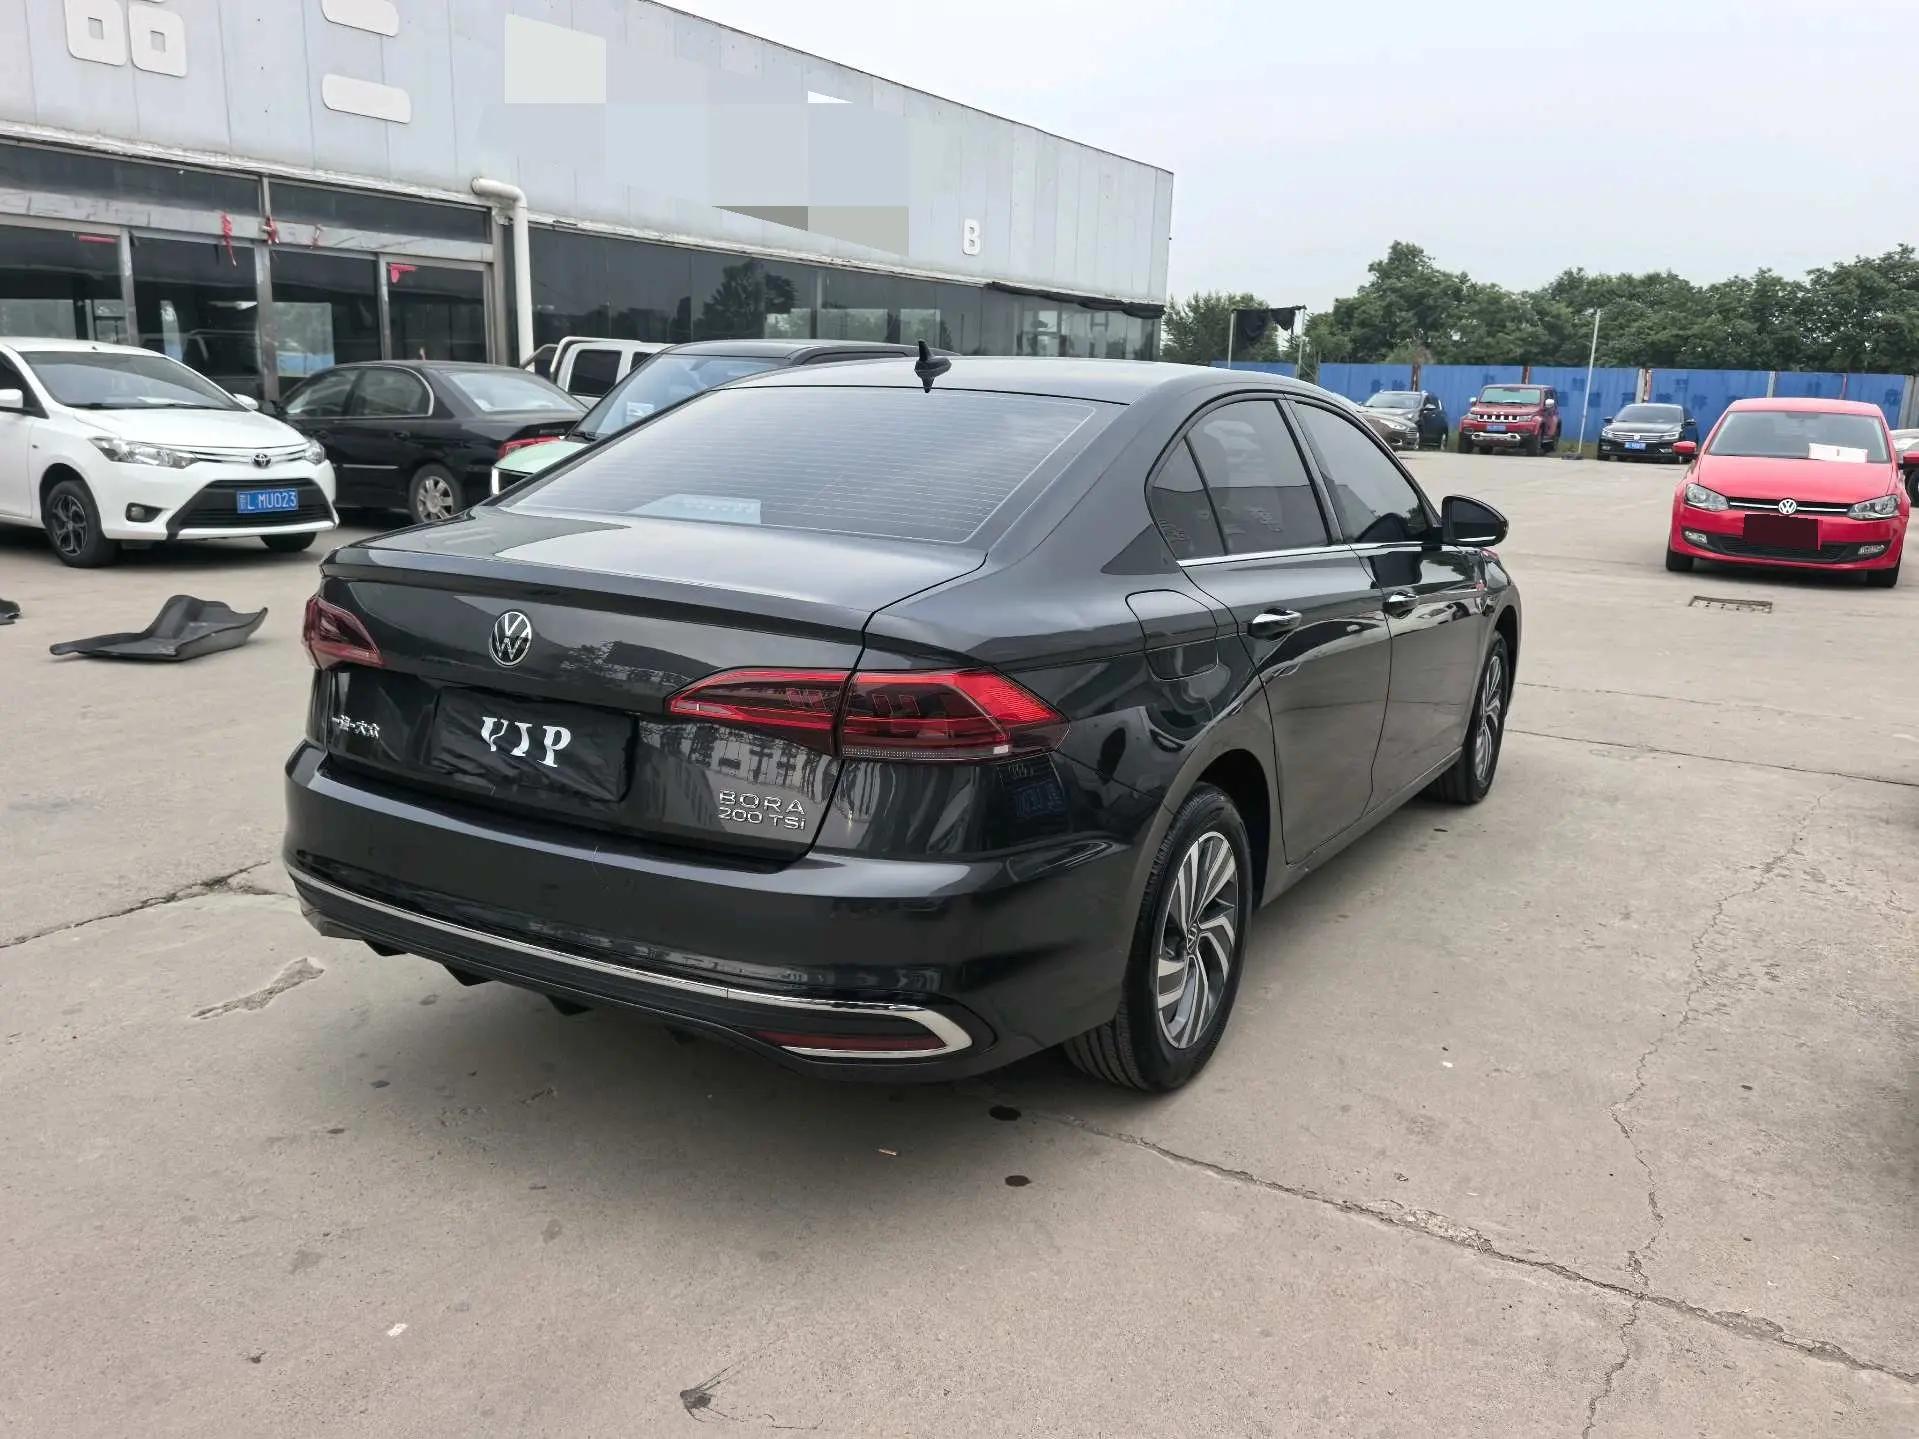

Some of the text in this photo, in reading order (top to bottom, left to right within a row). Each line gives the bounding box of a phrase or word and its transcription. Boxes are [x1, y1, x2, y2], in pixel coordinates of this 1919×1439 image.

[480, 716, 572, 768] VIP
[718, 789, 805, 815] BORA
[718, 806, 763, 824] 200
